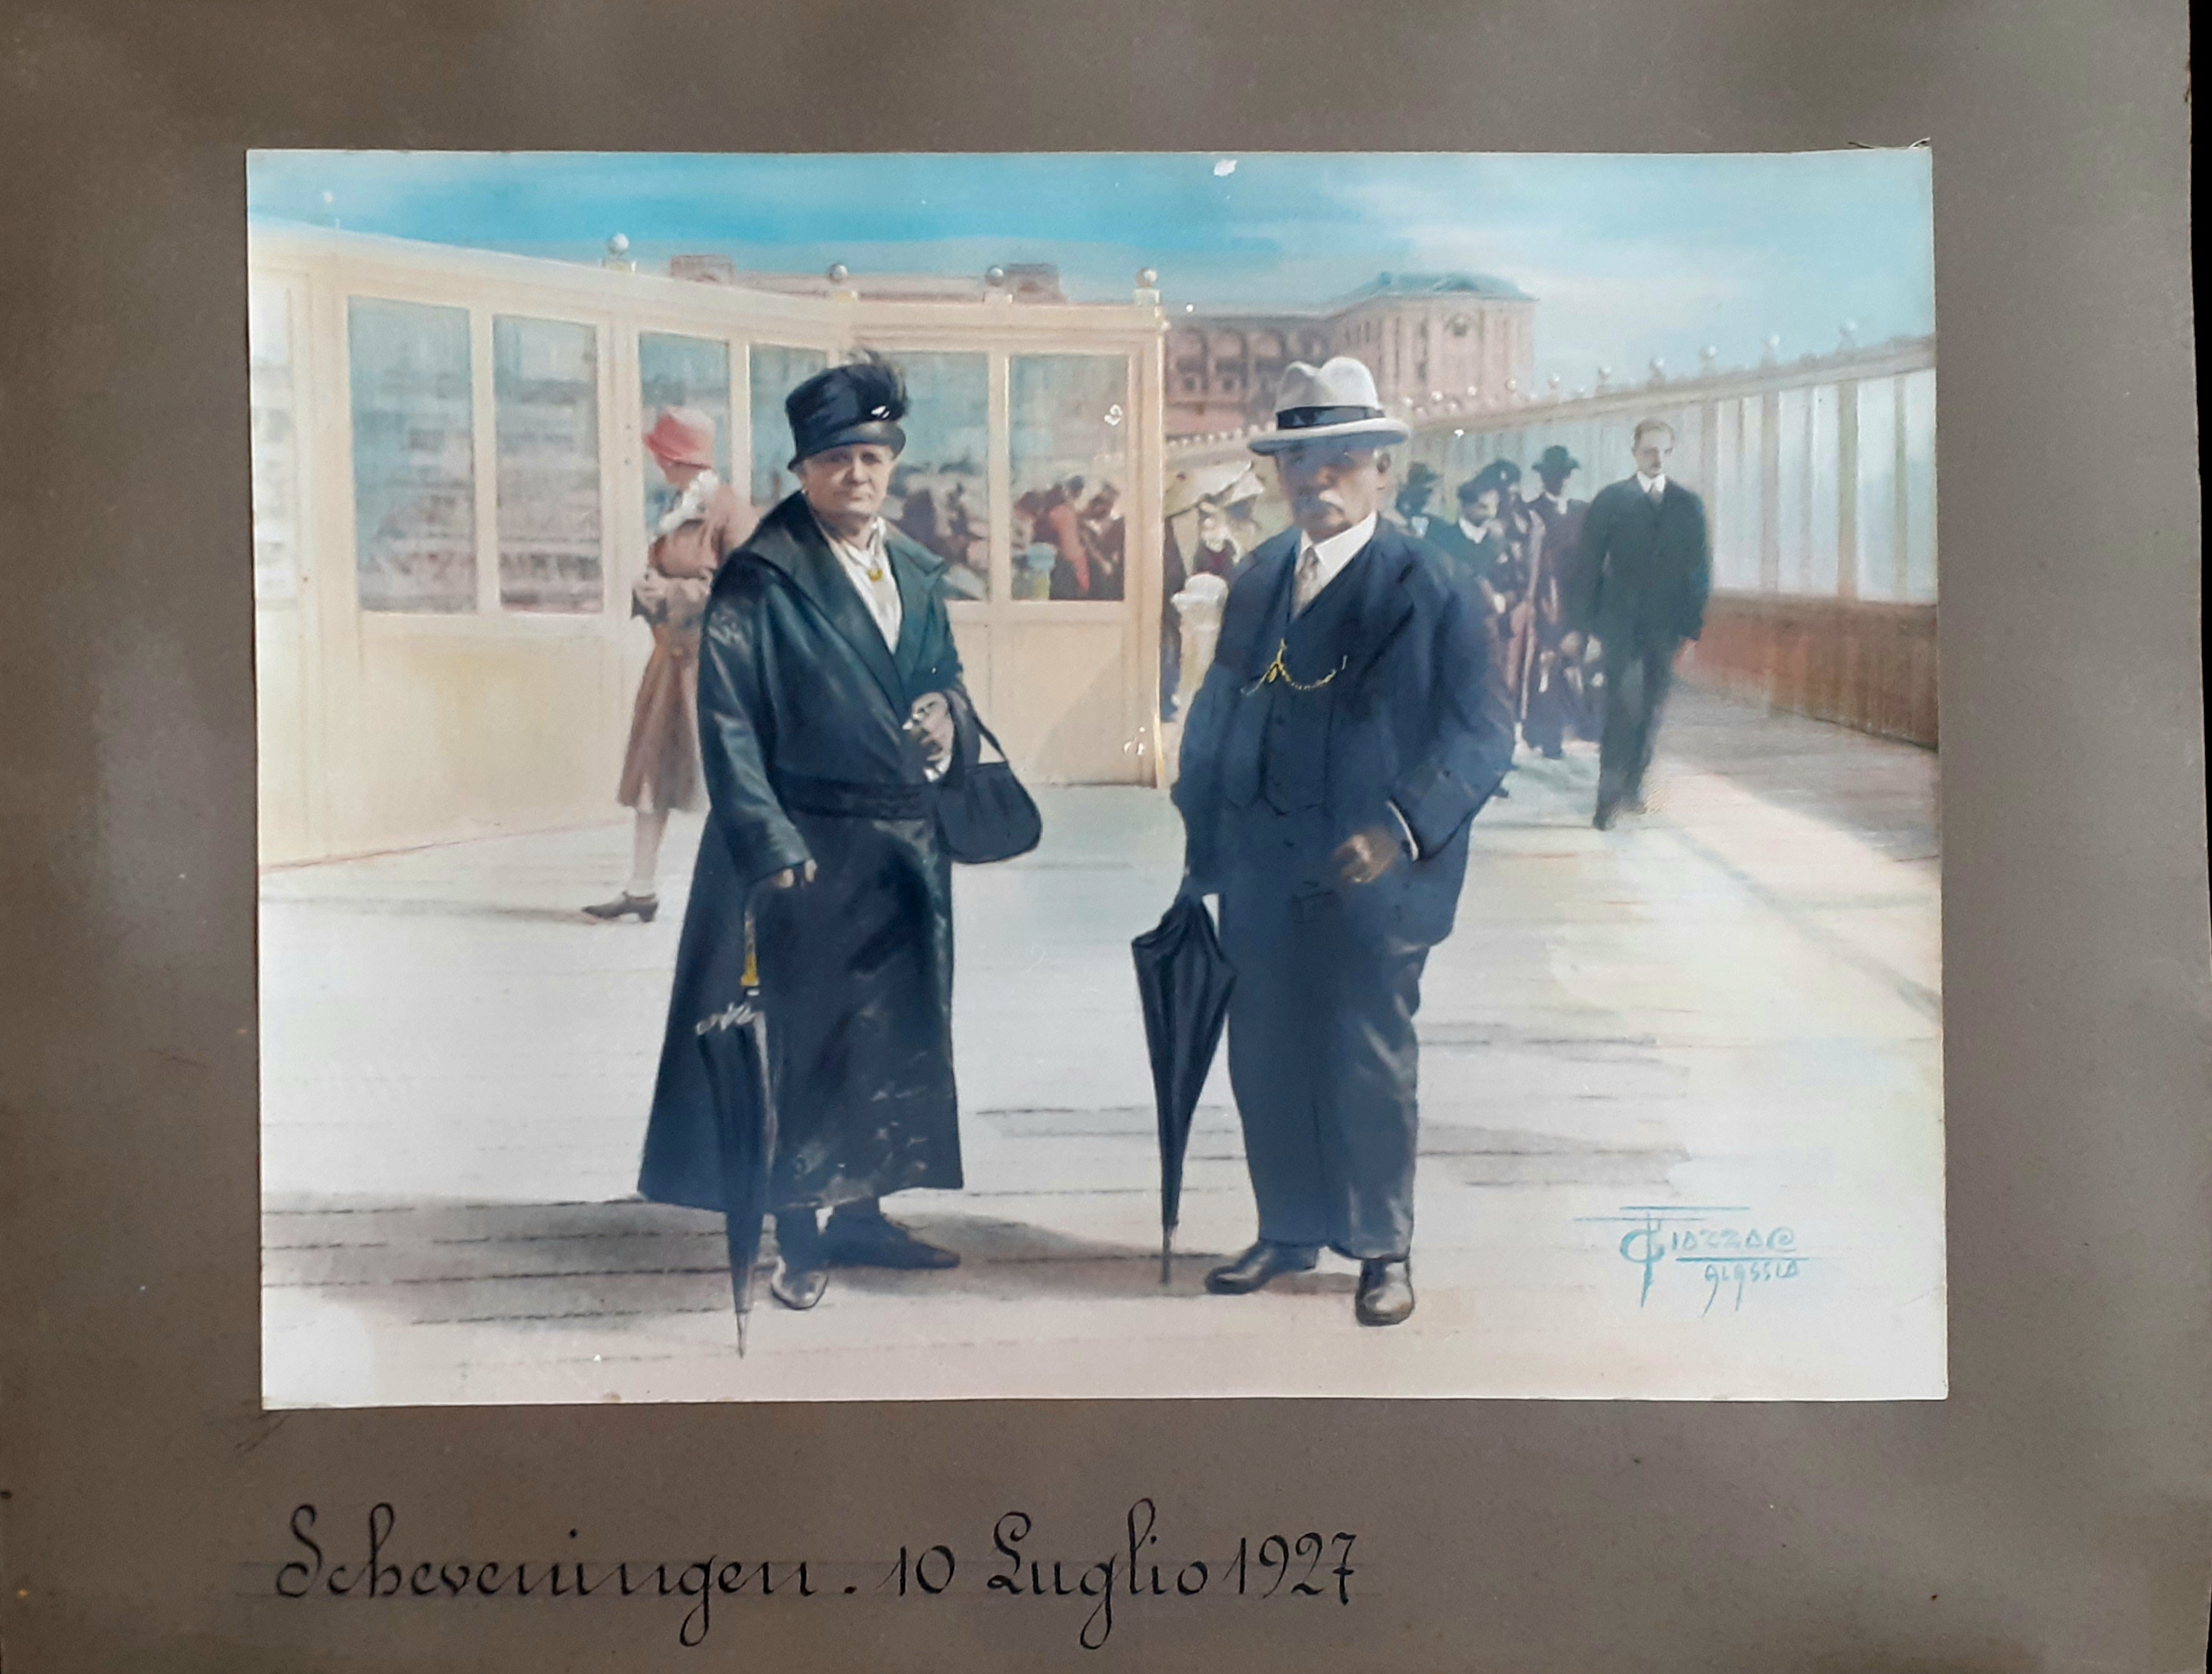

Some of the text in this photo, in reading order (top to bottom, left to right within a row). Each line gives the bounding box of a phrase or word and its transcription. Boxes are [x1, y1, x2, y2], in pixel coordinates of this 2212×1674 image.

[877, 1544, 956, 1597] 10
[987, 1497, 1208, 1650] Luglio
[1223, 1532, 1358, 1606] 1927
